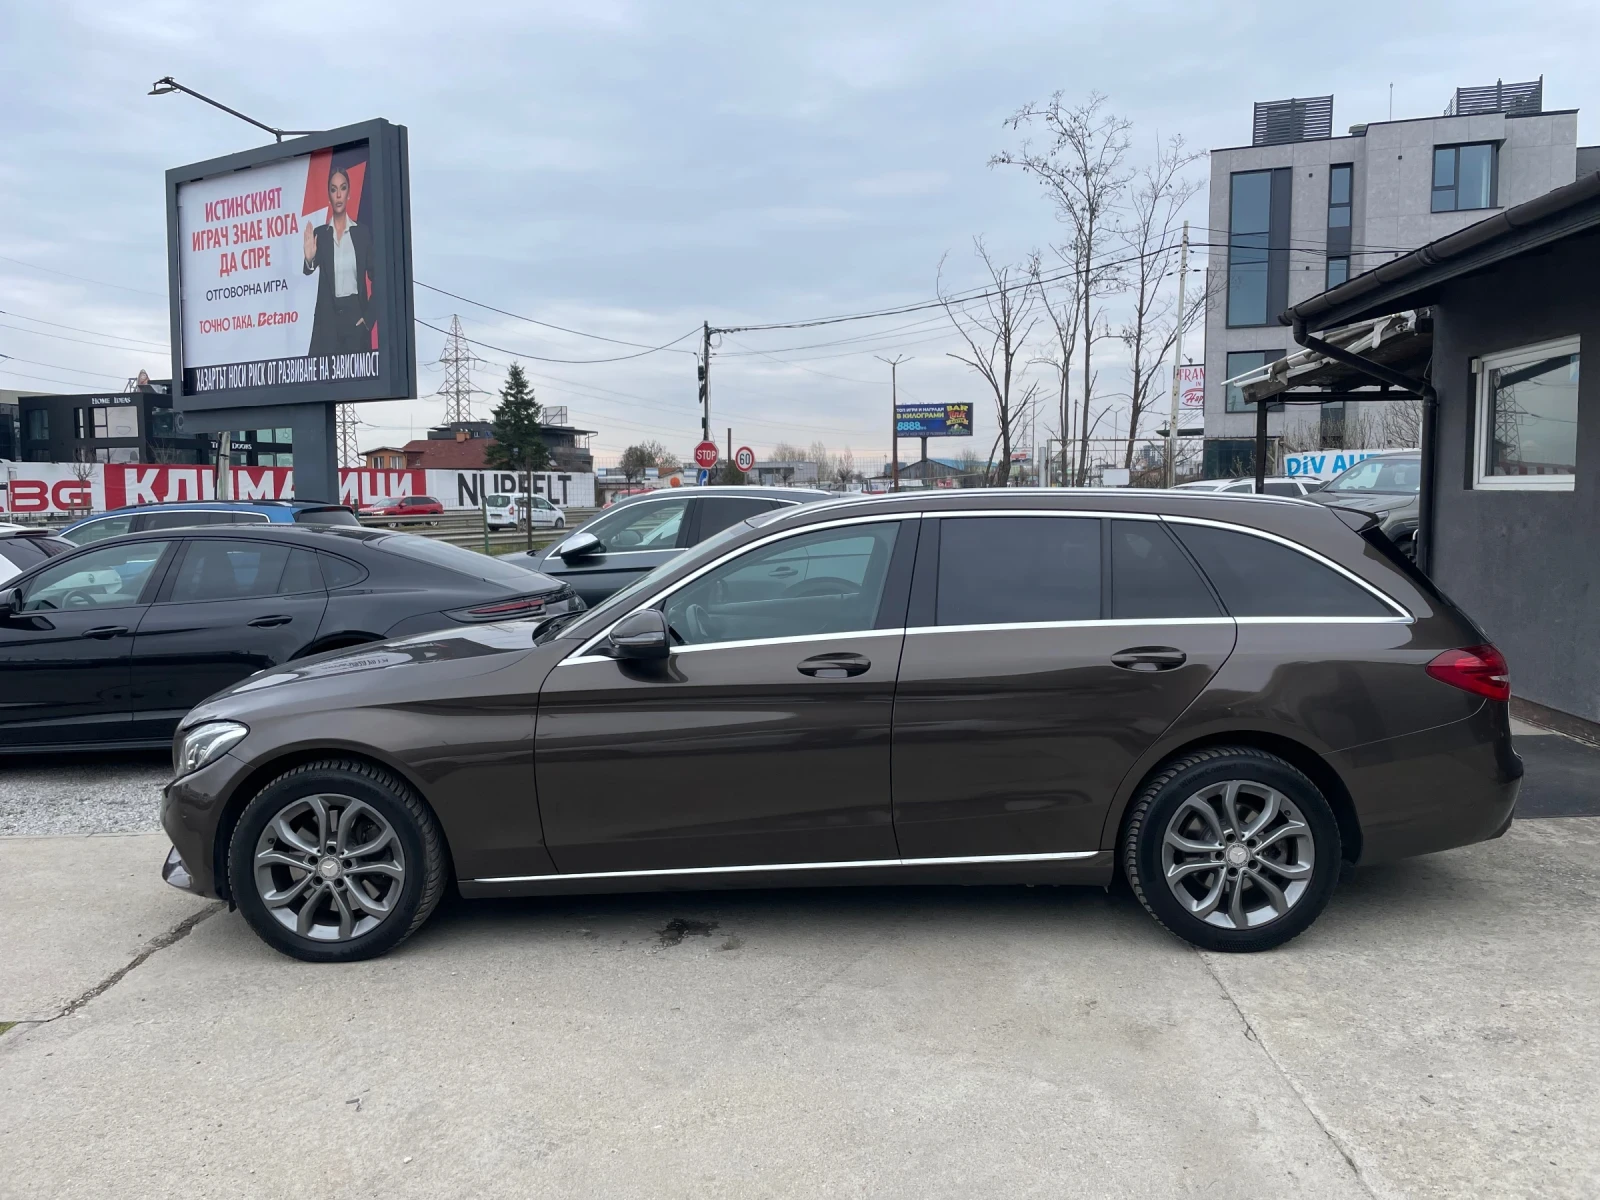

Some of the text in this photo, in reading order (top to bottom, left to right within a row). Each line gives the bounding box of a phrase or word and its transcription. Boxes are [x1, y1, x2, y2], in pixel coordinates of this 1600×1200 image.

[205, 187, 282, 222] ИСТИНСКИЯТ
[192, 213, 299, 252] ИГРАЧ ЗНАЕ КОГА
[220, 246, 271, 278] ДА СПРЕ
[206, 279, 288, 301] ОТГОВОРНА ИГРА
[199, 311, 299, 334] ТОЧНО ТАКА. Betano
[196, 351, 380, 392] ХАЗАРТЪТ НОСИ РИСК ОТ РАЗВИВАНЕ НА ЗАВИСИМОСТ
[113, 396, 132, 404] IDEAS
[696, 449, 716, 460] STOP
[739, 453, 751, 465] 60
